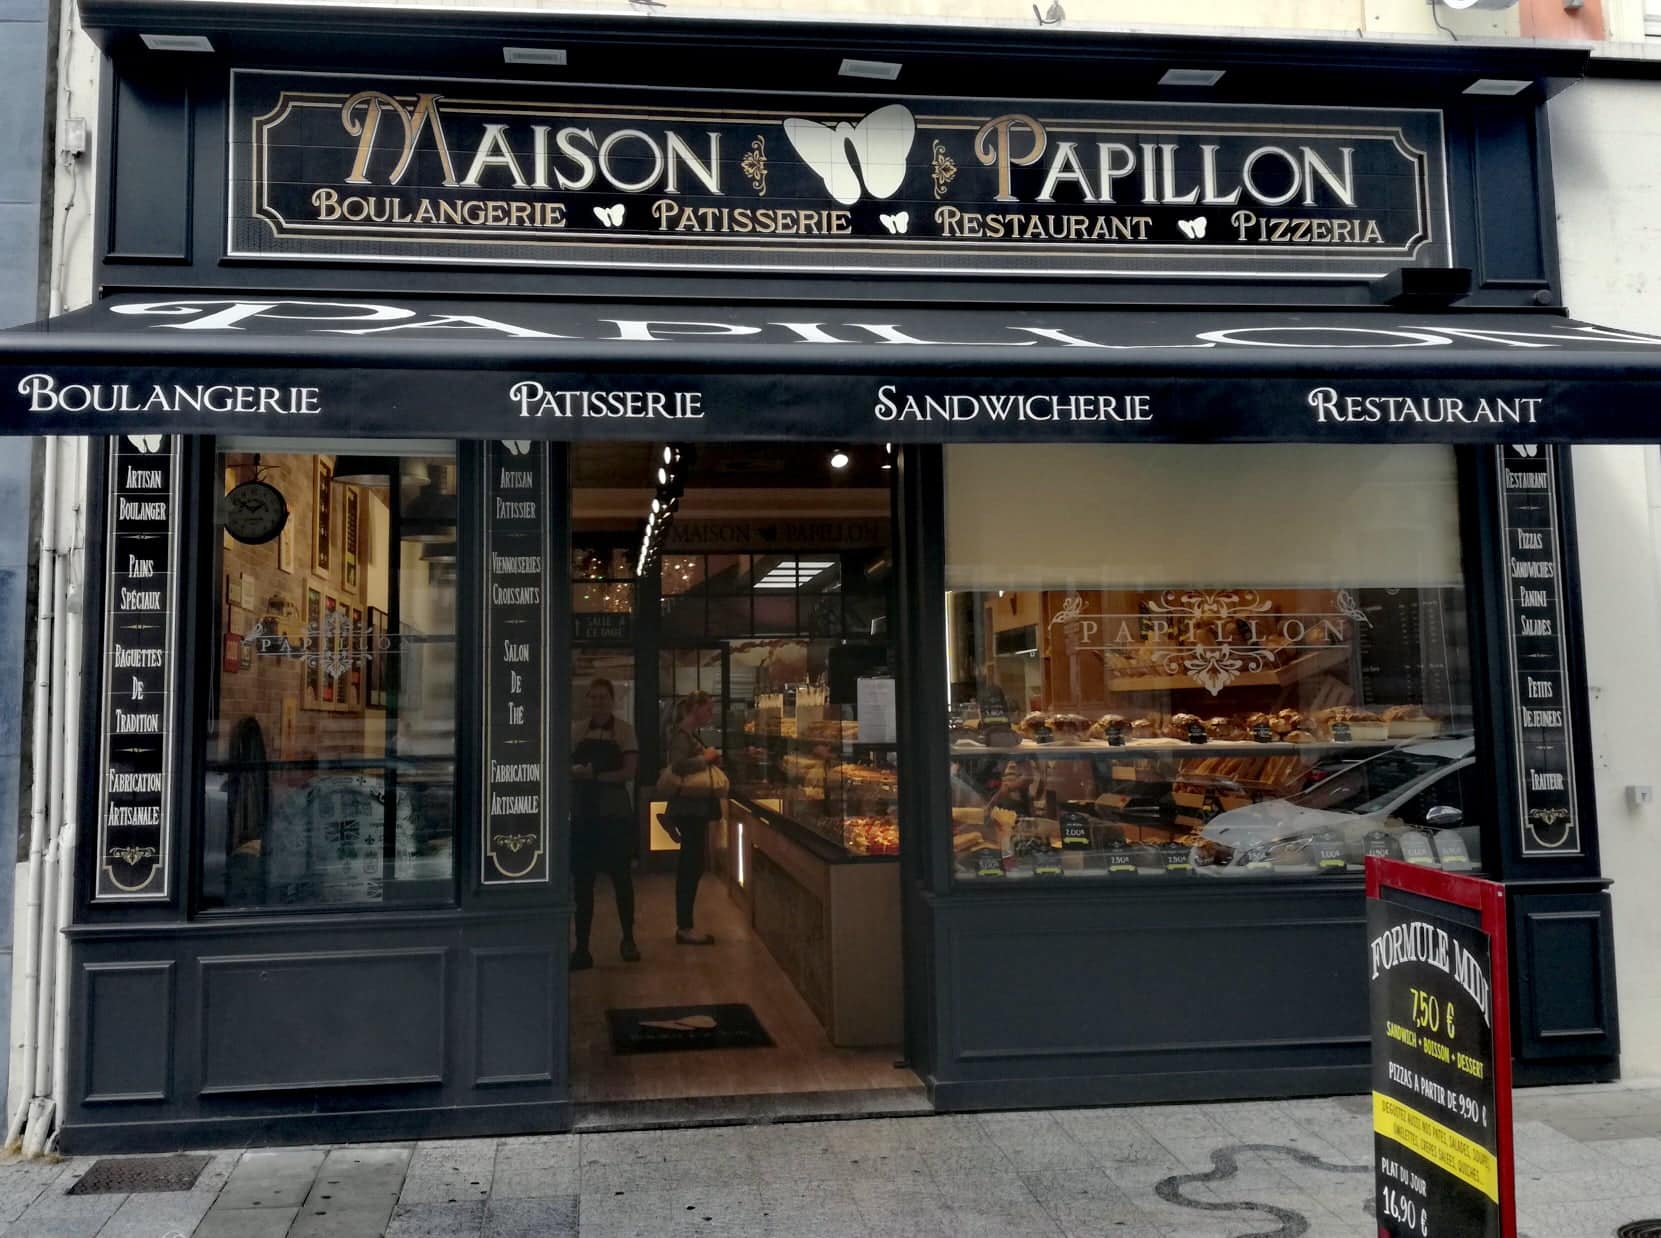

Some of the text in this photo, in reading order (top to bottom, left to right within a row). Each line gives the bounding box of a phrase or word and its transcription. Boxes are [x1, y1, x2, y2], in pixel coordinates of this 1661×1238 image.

[341, 90, 1358, 208] MAISON PAPILLON
[312, 188, 1385, 244] BOULANGERIE PATISSERIE RESTAURANT PIZZERIA
[18, 373, 1542, 425] BOULANGERIE PATISSERIE SANDWICHERIE RESTAURANT
[126, 465, 162, 488] ARTISAN
[500, 467, 533, 488] ARTISAN
[1505, 467, 1548, 489] RESTAURANT
[119, 497, 167, 521] BOULANGER
[496, 497, 536, 519] PATISSIER
[1518, 528, 1543, 549] PIZZAS
[128, 554, 154, 578] PAINS
[492, 552, 541, 574] VIENNOISERIES
[1511, 557, 1554, 579] SANDWICHES
[120, 587, 161, 610] SPÉCIAUX
[492, 583, 540, 605] CROISSANTS
[1080, 618, 1345, 643] PAPILLON
[1521, 614, 1552, 636] SALADES
[115, 644, 162, 667] BAGUETTES
[504, 639, 530, 662] SALON
[132, 676, 144, 700] DE
[510, 670, 522, 693] DE
[1527, 676, 1553, 698] PETITS
[115, 709, 158, 733] TRADITION
[109, 768, 161, 793] FABRICATION
[491, 760, 540, 783] FABRICATION
[1530, 769, 1564, 791] TRAITEUR
[107, 801, 160, 826] ARTISANALE
[491, 792, 539, 815] ARTISANALE
[1371, 921, 1490, 1029] FORMULE MIDI
[1446, 1002, 1455, 1039] €
[1386, 1020, 1484, 1080] SANDWICH BOISSON DESSERT
[1388, 1061, 1413, 1089] PIZZAS
[1421, 1077, 1446, 1107] PARTIR
[1447, 1089, 1458, 1113] DE
[1459, 1094, 1480, 1124] 9,90
[1381, 1156, 1427, 1198] PLAT DU JOUR
[1382, 1185, 1428, 1237] 16,90 €
